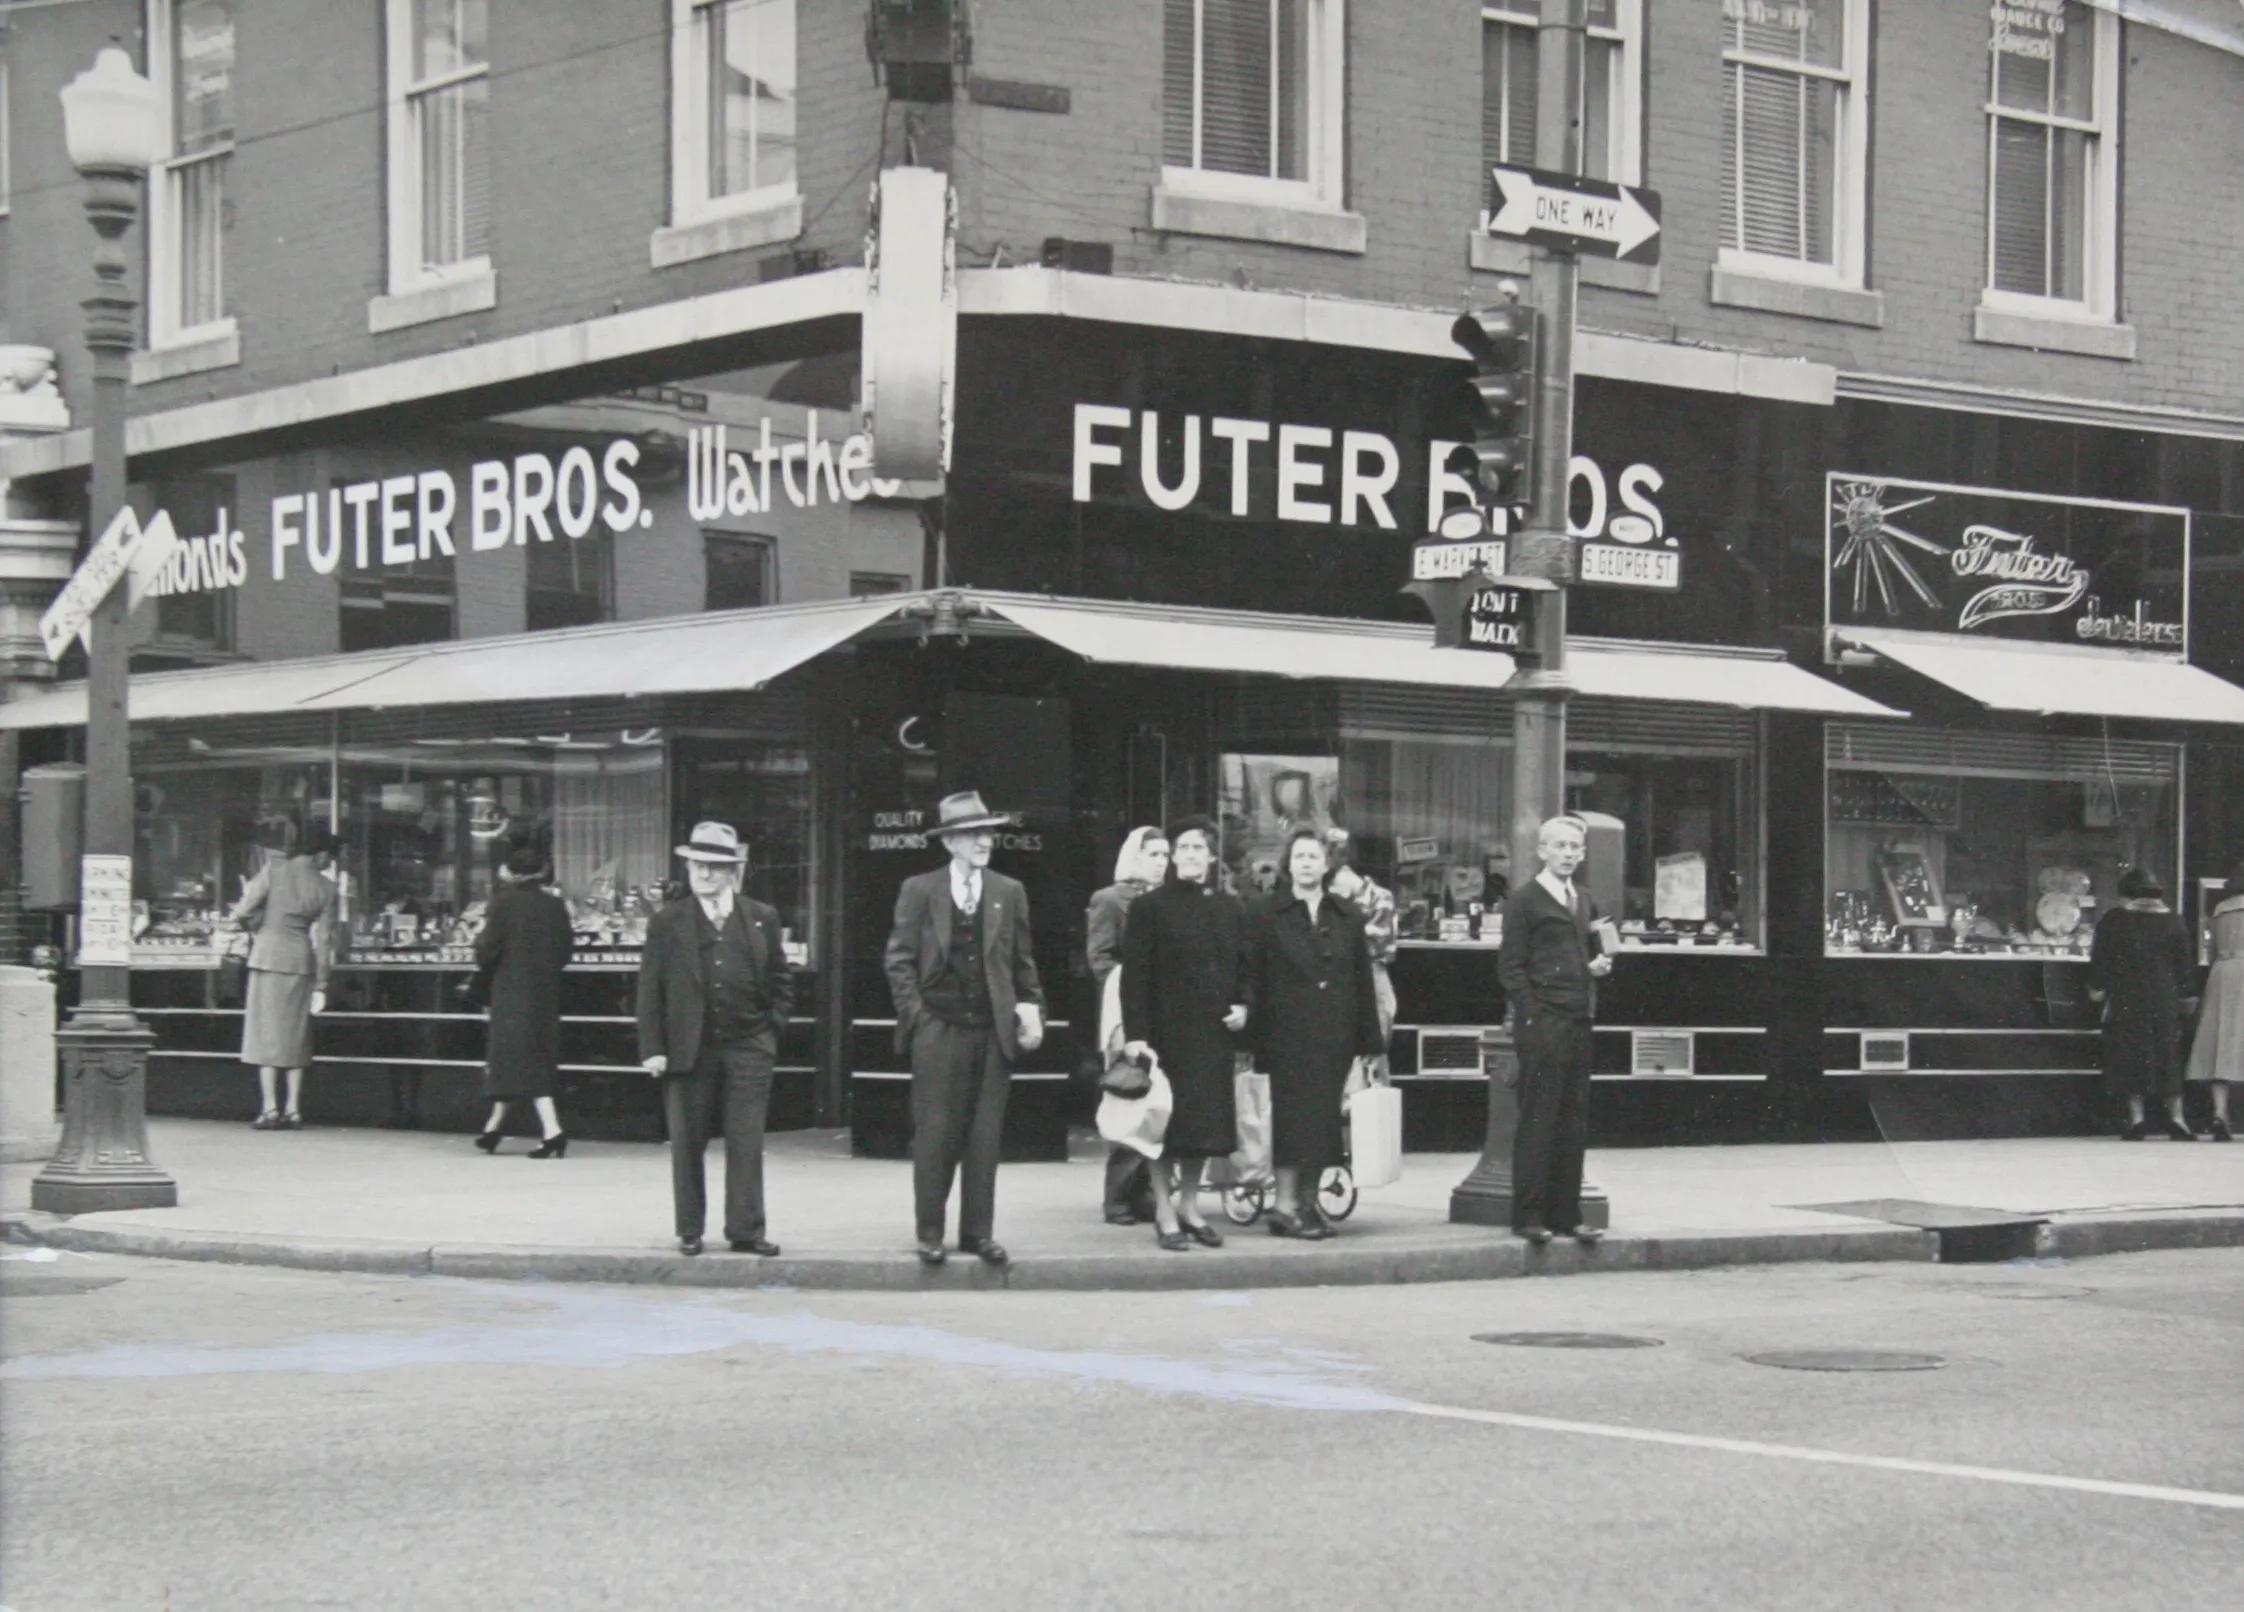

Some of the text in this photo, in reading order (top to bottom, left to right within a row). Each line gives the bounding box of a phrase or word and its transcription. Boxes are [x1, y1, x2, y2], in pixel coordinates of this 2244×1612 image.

[1536, 195, 1617, 233] ONE WAY
[1072, 402, 1680, 546] FUTER BOS.
[271, 470, 457, 581] FUTER
[472, 439, 653, 552] BROS.
[687, 408, 901, 522] Watche
[1486, 543, 1503, 576] ST
[1599, 549, 1651, 579] GEORGE
[1655, 553, 1672, 580] ST
[1470, 618, 1521, 645] WALK
[874, 810, 924, 828] QUALITY
[868, 832, 929, 851] DIAMONDS
[992, 832, 1043, 851] TCHES
